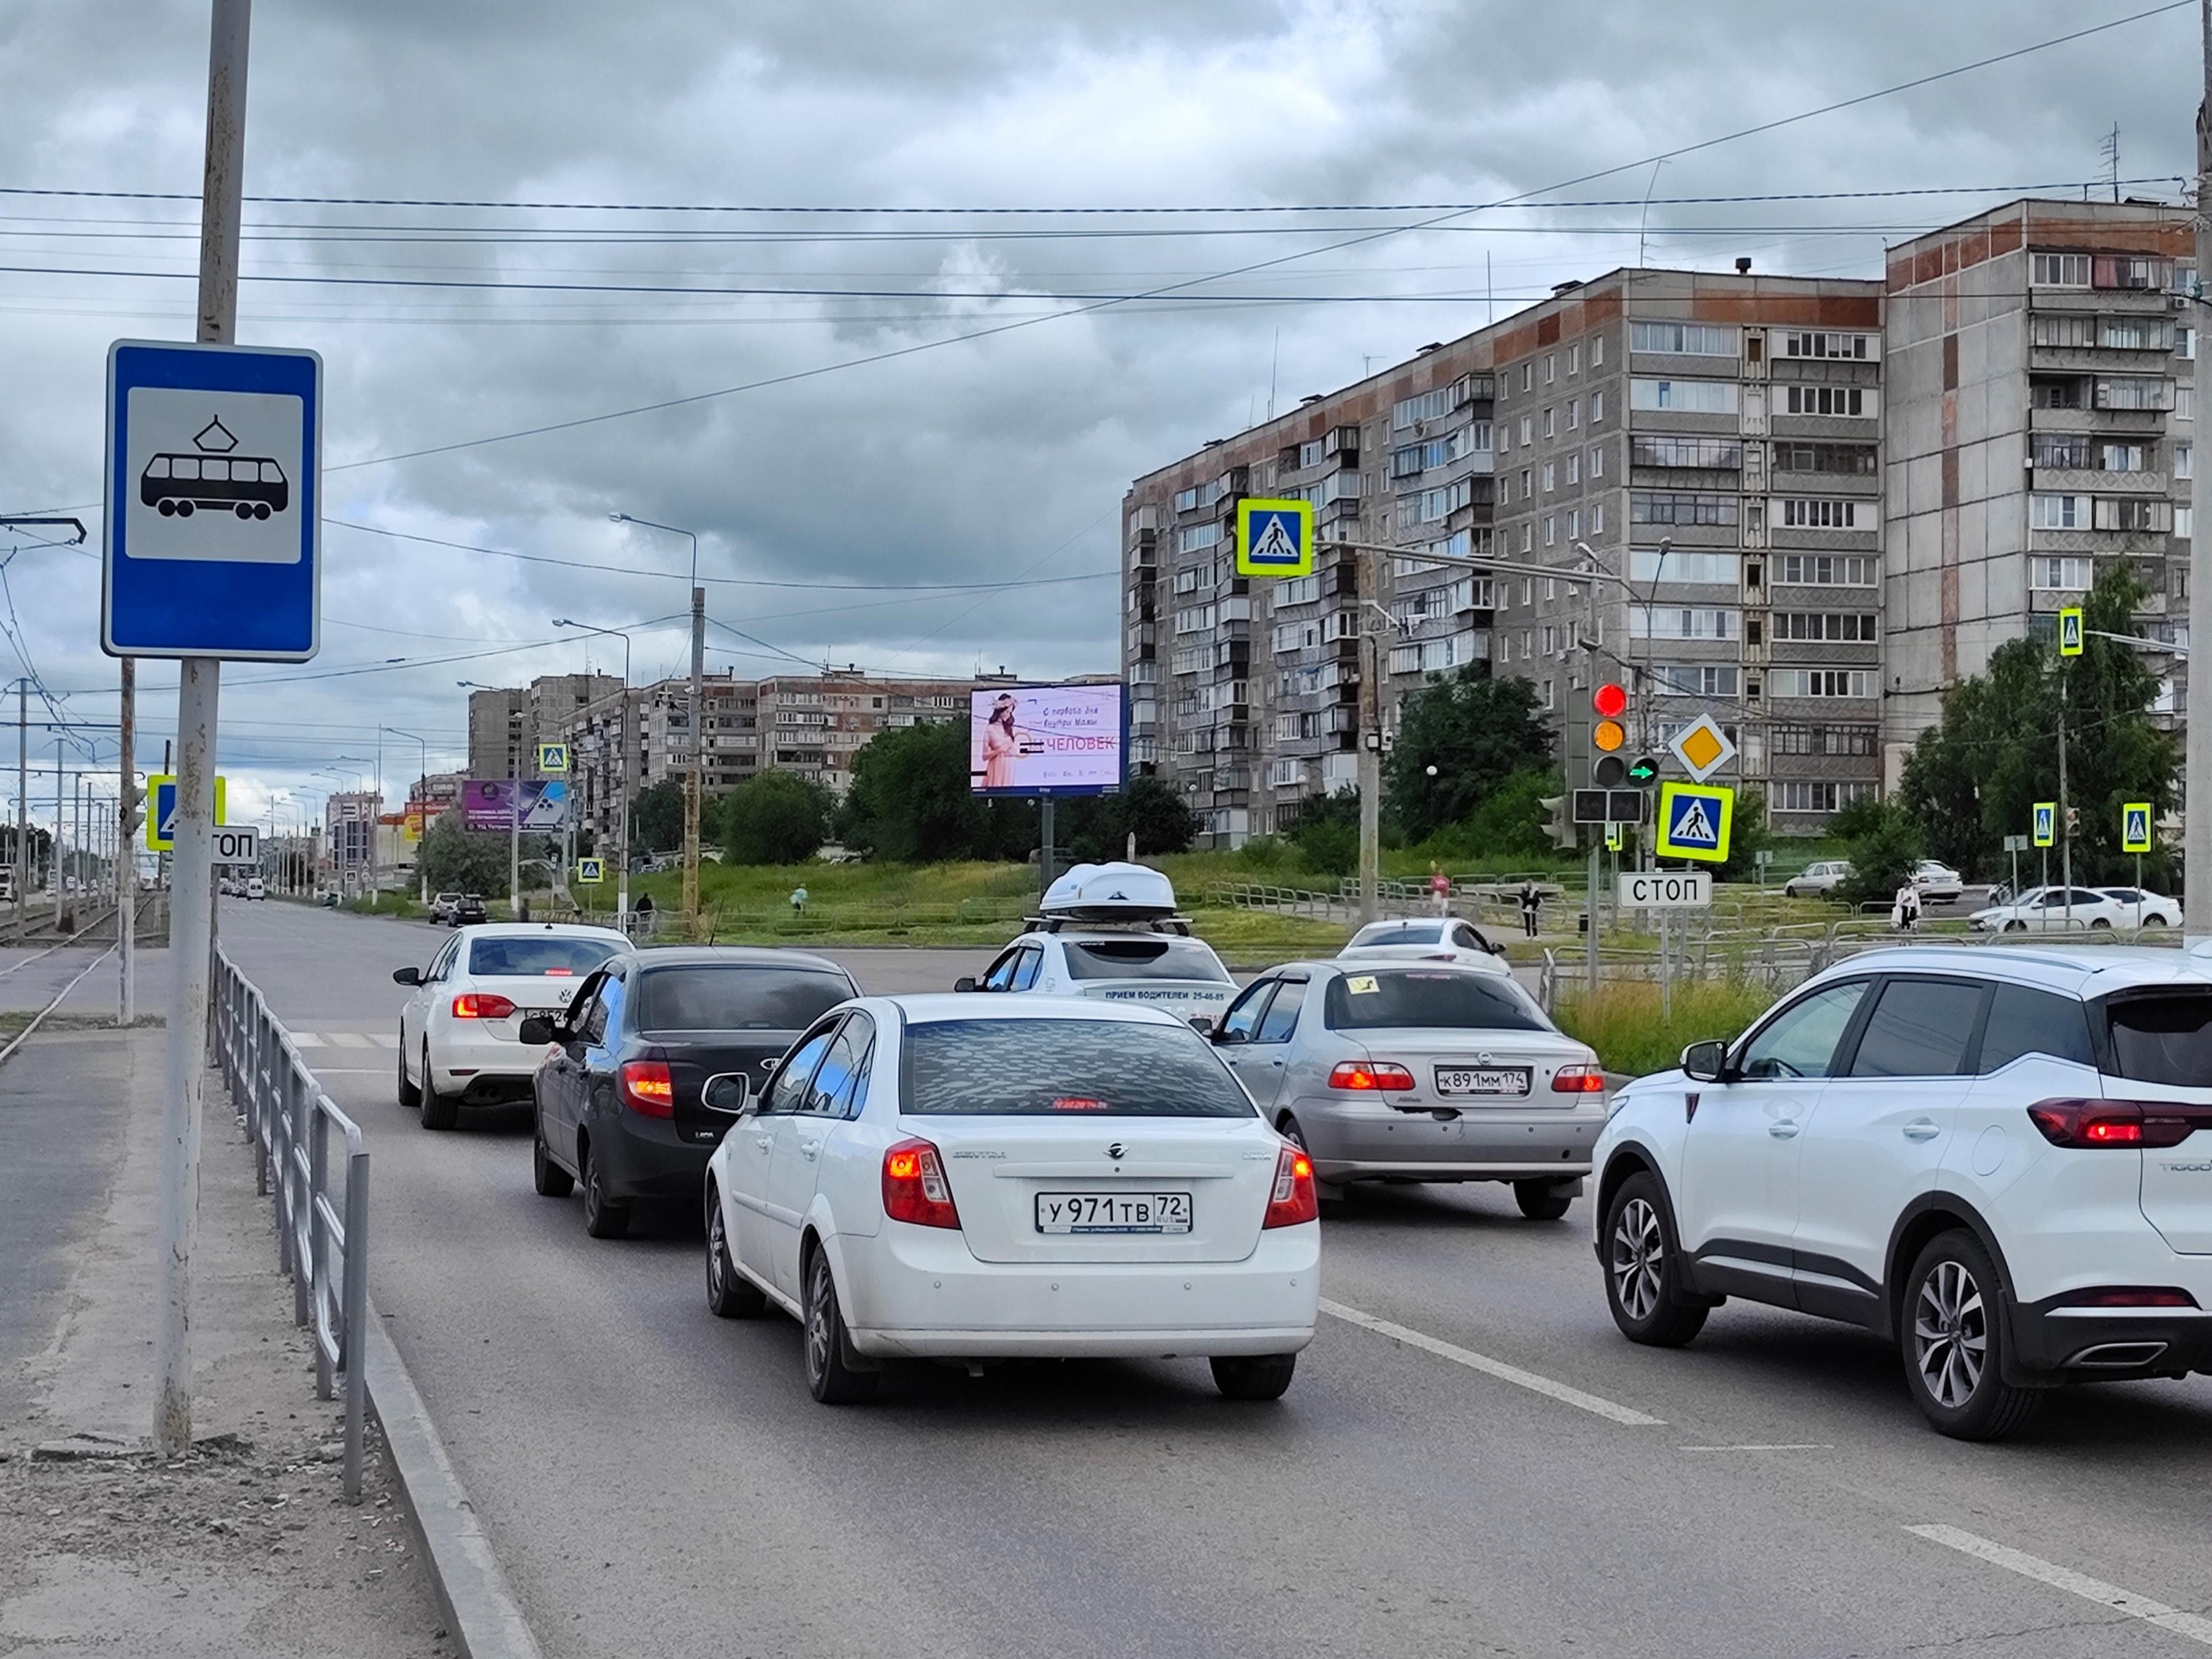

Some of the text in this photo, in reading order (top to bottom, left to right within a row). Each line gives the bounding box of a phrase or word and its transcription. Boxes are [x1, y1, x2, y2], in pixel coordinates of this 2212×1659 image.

[1047, 737, 1114, 751] ЧЕЛОВЕК
[1633, 879, 1697, 901] СТОП
[1105, 991, 1135, 999] ПРИЕМ
[1049, 1196, 1182, 1223] У971ТВ 72
